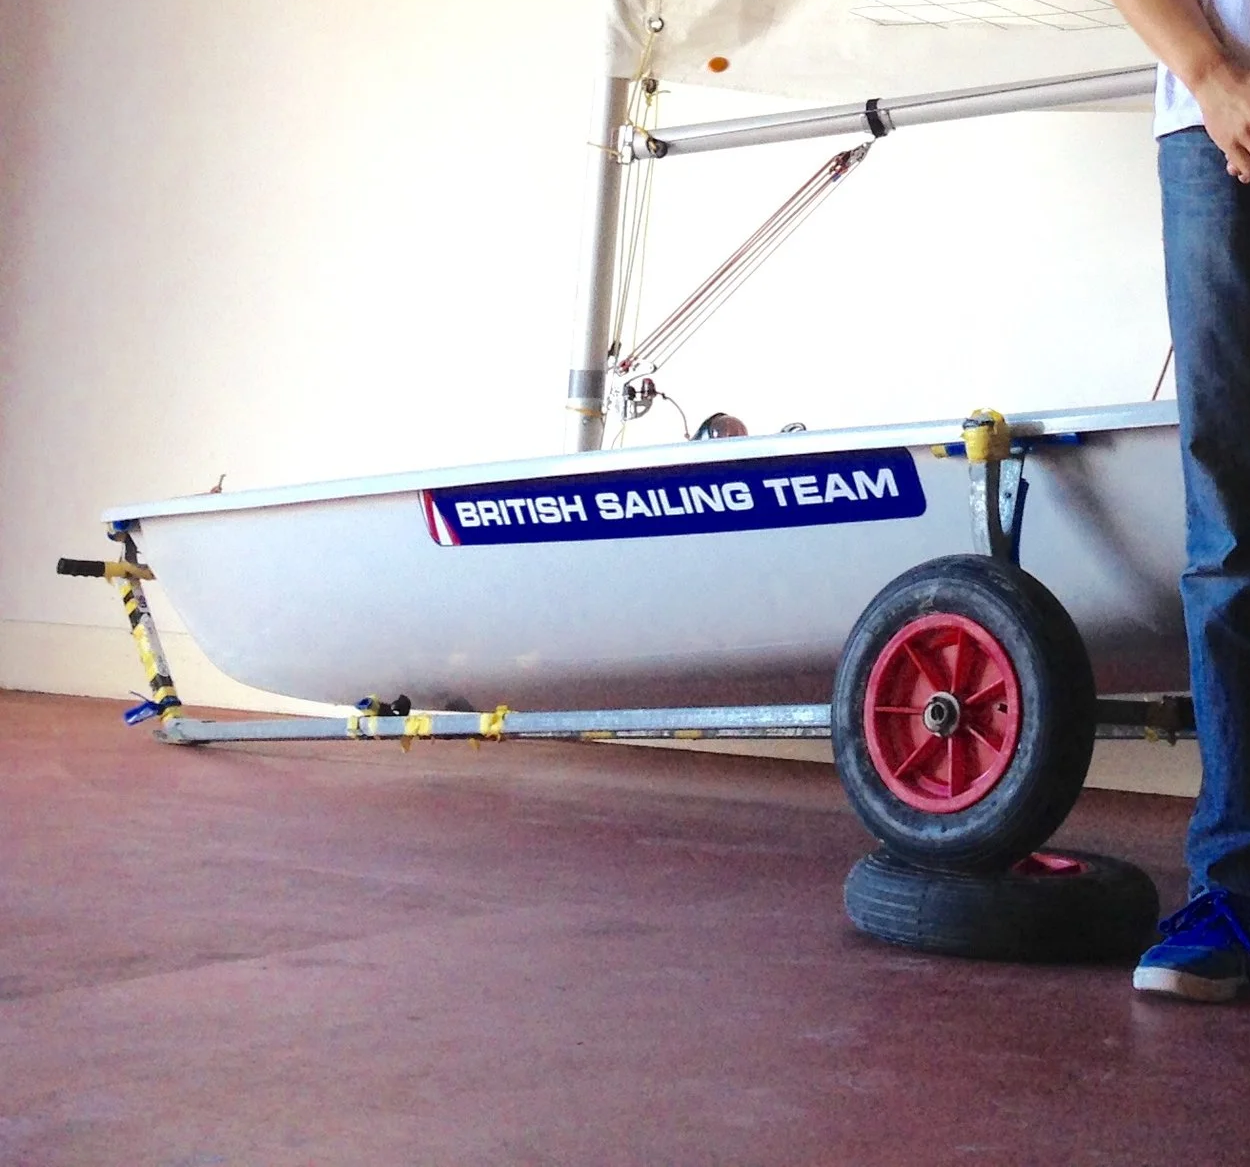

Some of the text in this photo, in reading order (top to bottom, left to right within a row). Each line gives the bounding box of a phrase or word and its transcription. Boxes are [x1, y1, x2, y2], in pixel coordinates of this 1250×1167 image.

[455, 466, 900, 528] BRITISH SAILING TEAM
